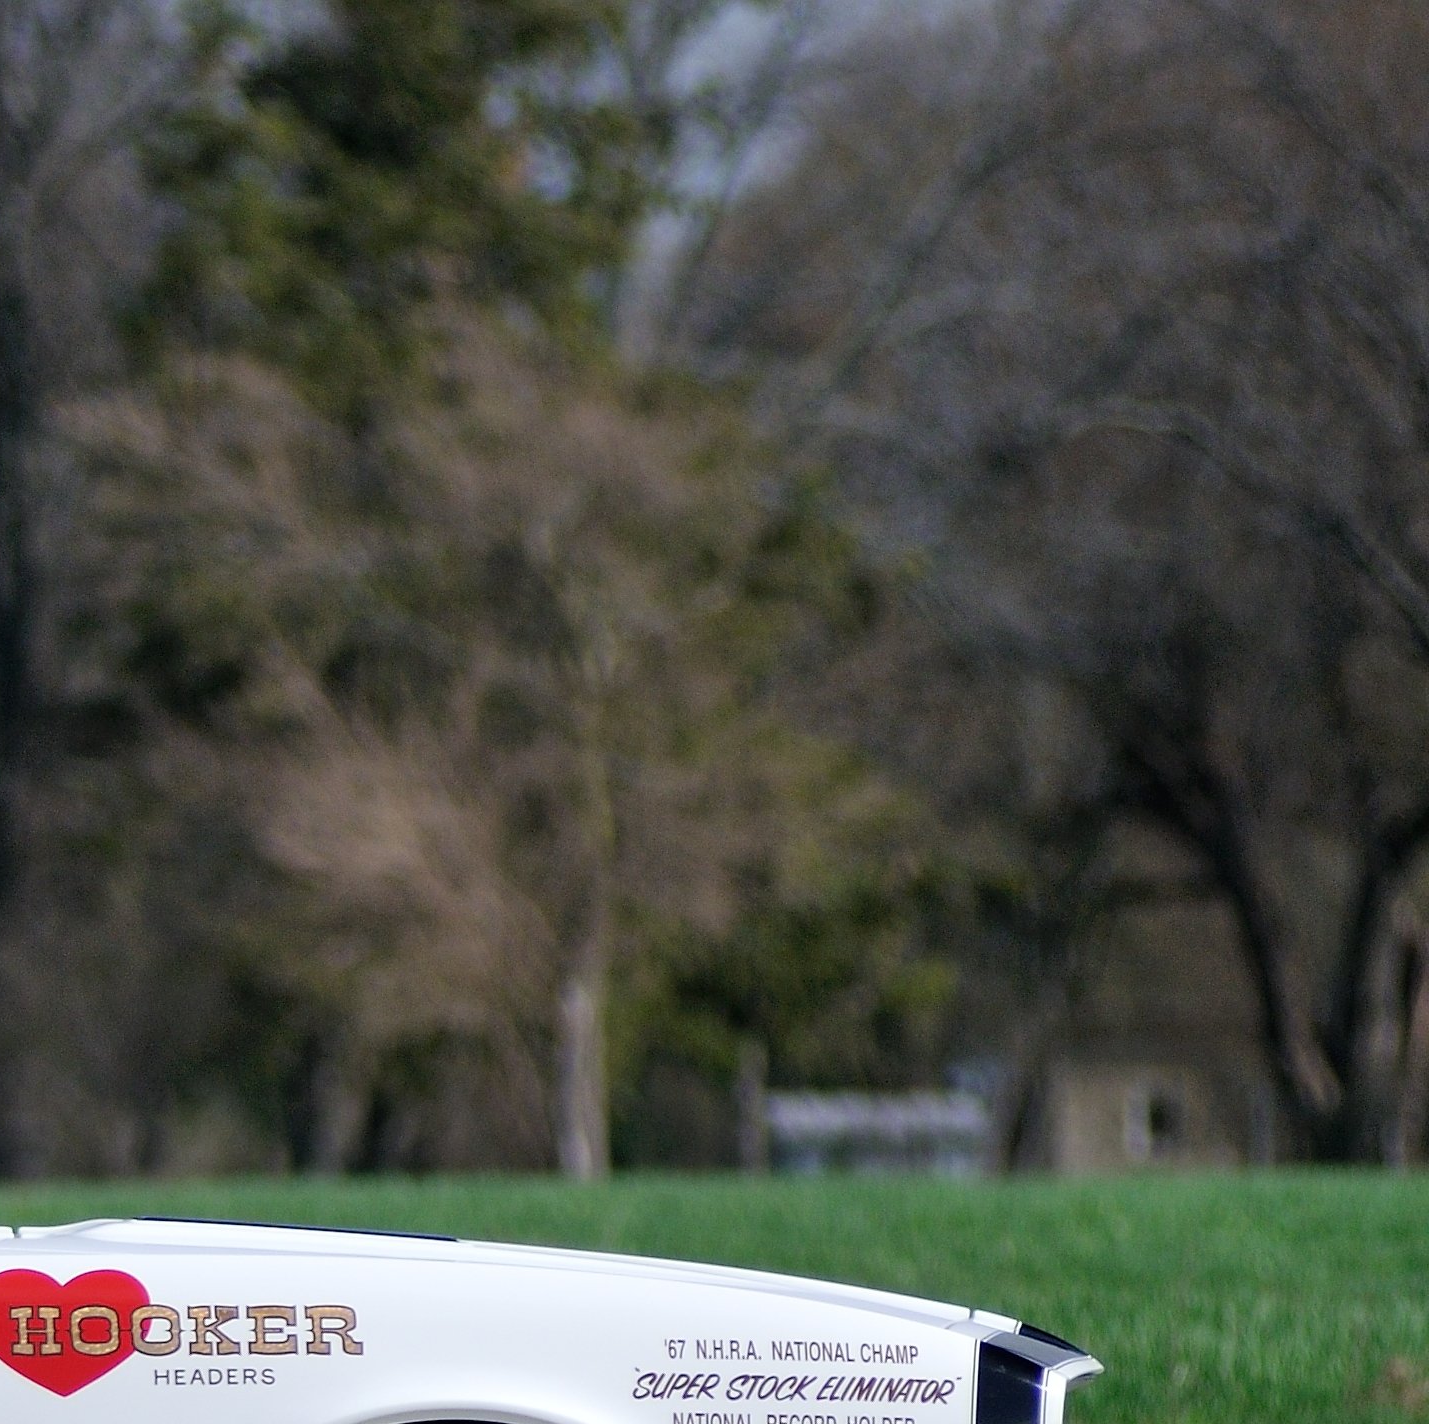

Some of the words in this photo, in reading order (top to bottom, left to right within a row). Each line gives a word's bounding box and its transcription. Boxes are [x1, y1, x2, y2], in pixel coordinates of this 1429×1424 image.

[9, 1304, 364, 1356] HOOKER
[664, 1340, 686, 1359] '67
[696, 1340, 762, 1360] N.H.R.A.
[772, 1341, 856, 1363] NATIONAL
[860, 1343, 919, 1364] CHAMP
[154, 1368, 276, 1386] HEADERS
[726, 1374, 817, 1401] STOCK
